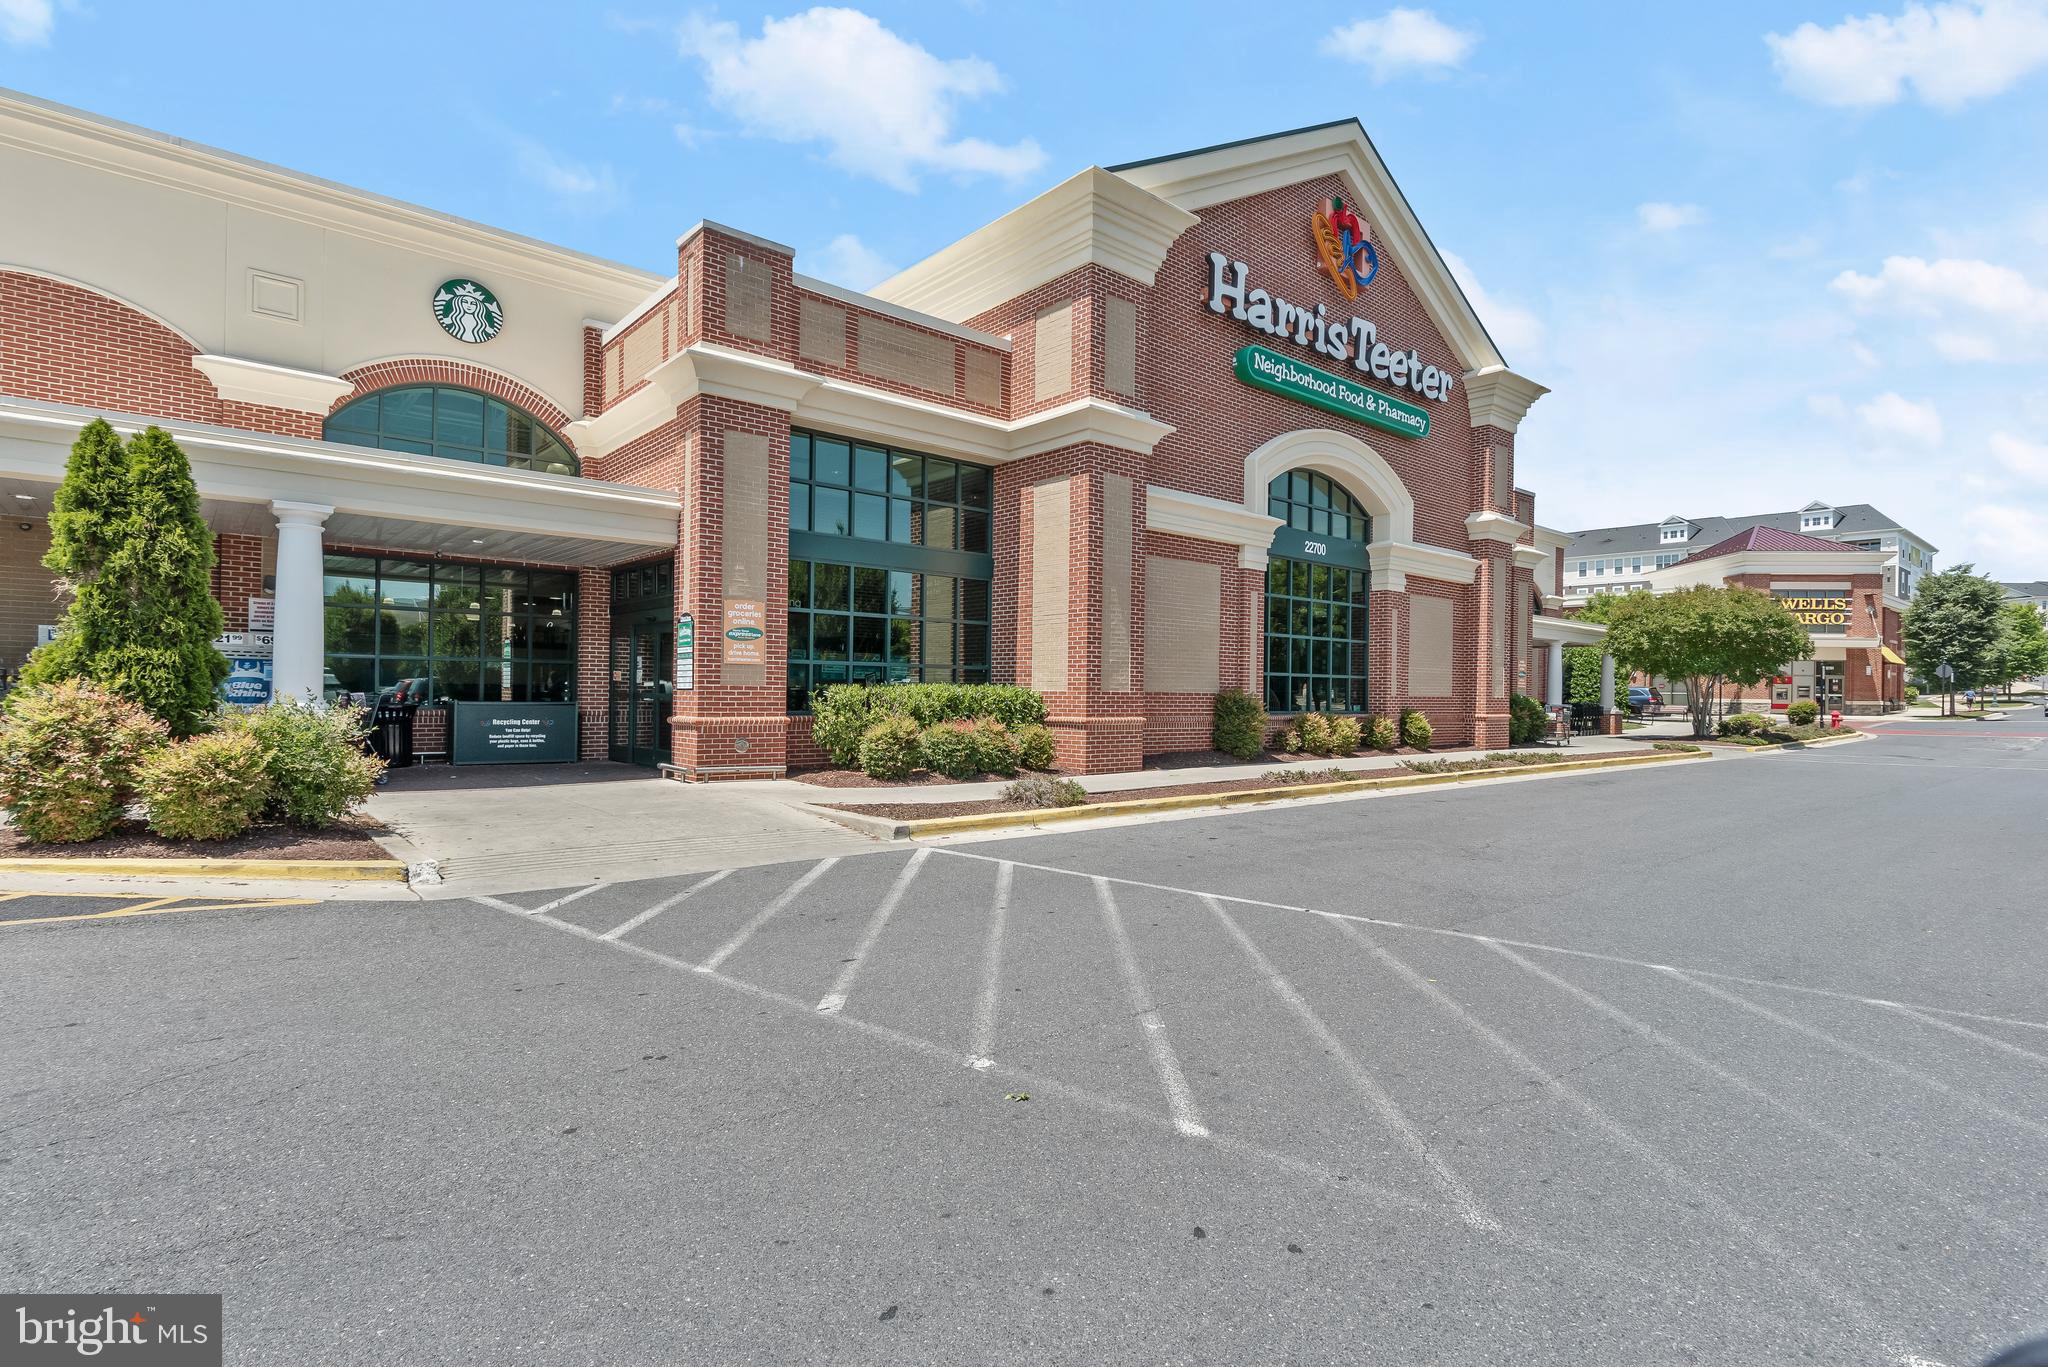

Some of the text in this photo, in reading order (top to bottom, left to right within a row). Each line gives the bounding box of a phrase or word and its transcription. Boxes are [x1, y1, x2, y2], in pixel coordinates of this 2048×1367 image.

[1207, 251, 1453, 403] Harris Teeter
[1253, 352, 1427, 433] Neighborhood Food & Pharmacy
[1304, 540, 1327, 556] 22700
[1781, 598, 1846, 610] WELLS
[727, 610, 762, 618] groceries
[1790, 612, 1844, 625] ARGO
[232, 681, 262, 690] Blue
